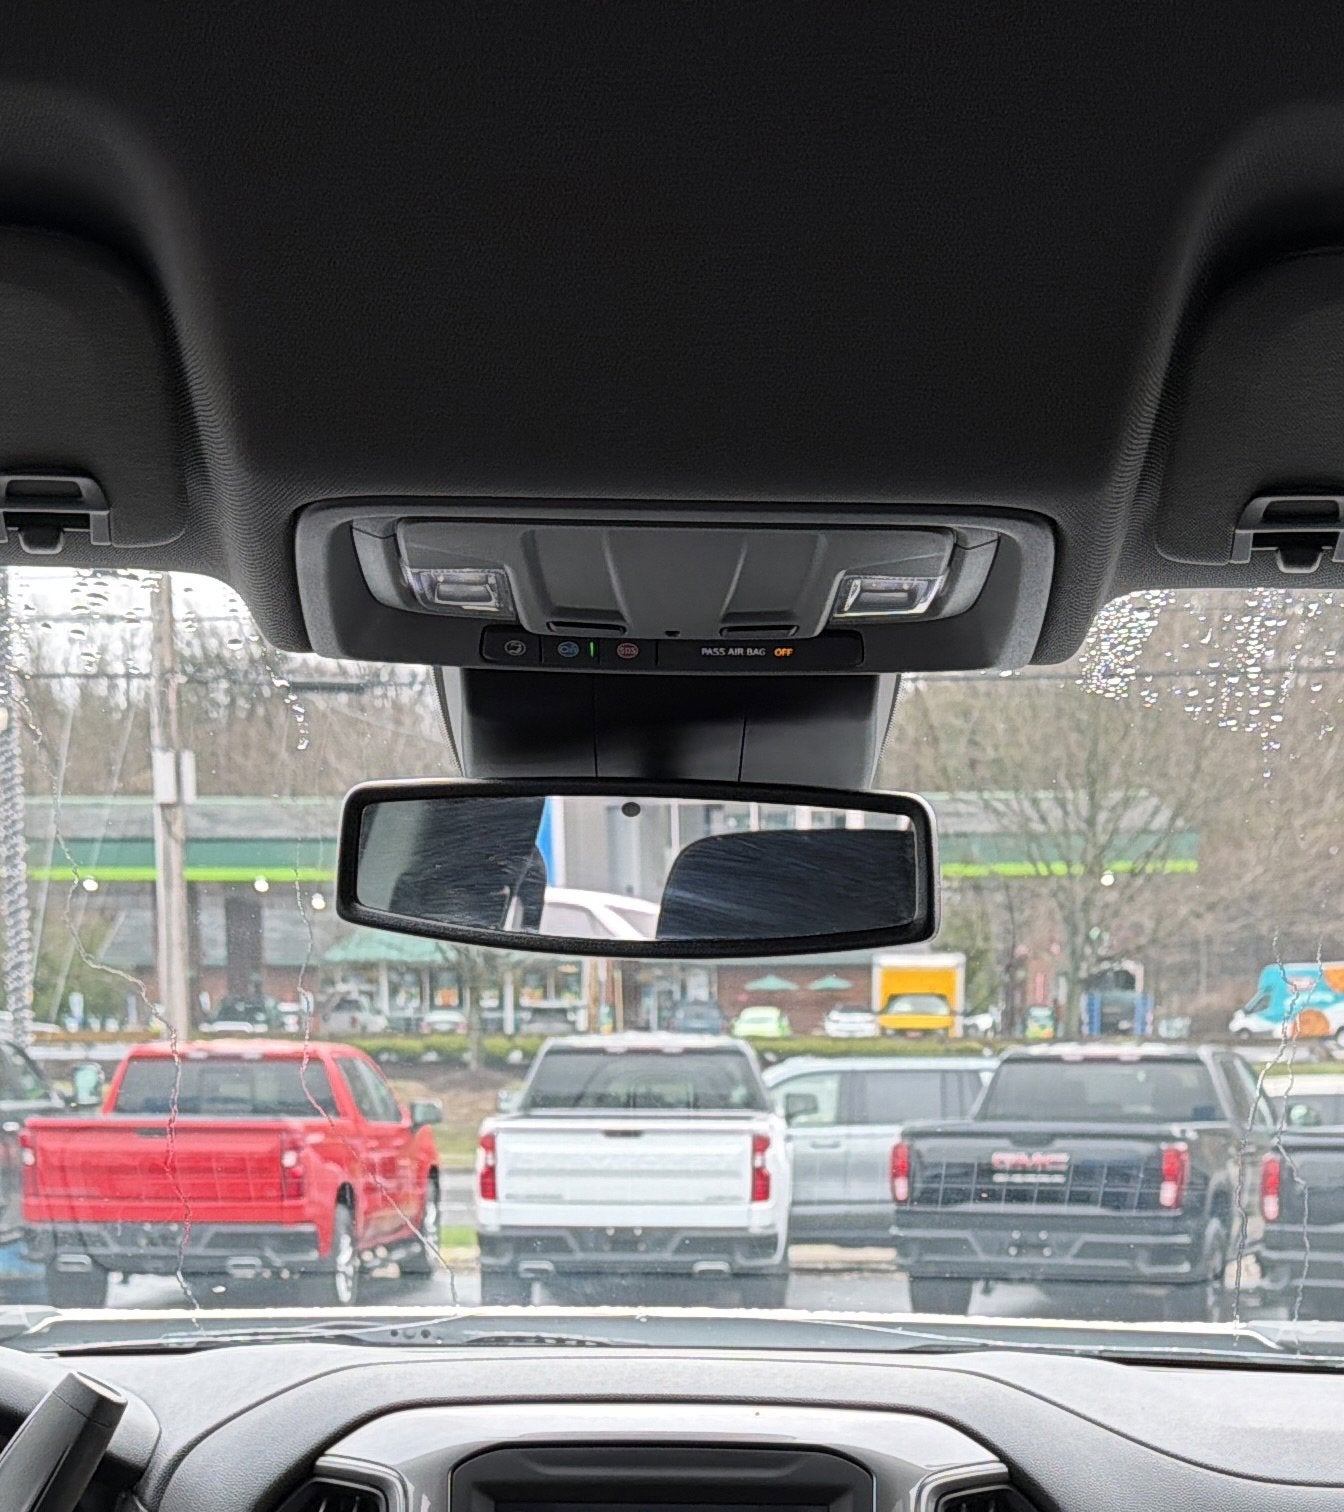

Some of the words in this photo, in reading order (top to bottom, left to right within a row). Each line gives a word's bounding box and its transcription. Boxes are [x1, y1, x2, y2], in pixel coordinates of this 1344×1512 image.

[701, 646, 726, 656] PASS
[727, 646, 744, 656] AIR
[746, 647, 766, 656] BAG
[774, 647, 794, 657] OFF
